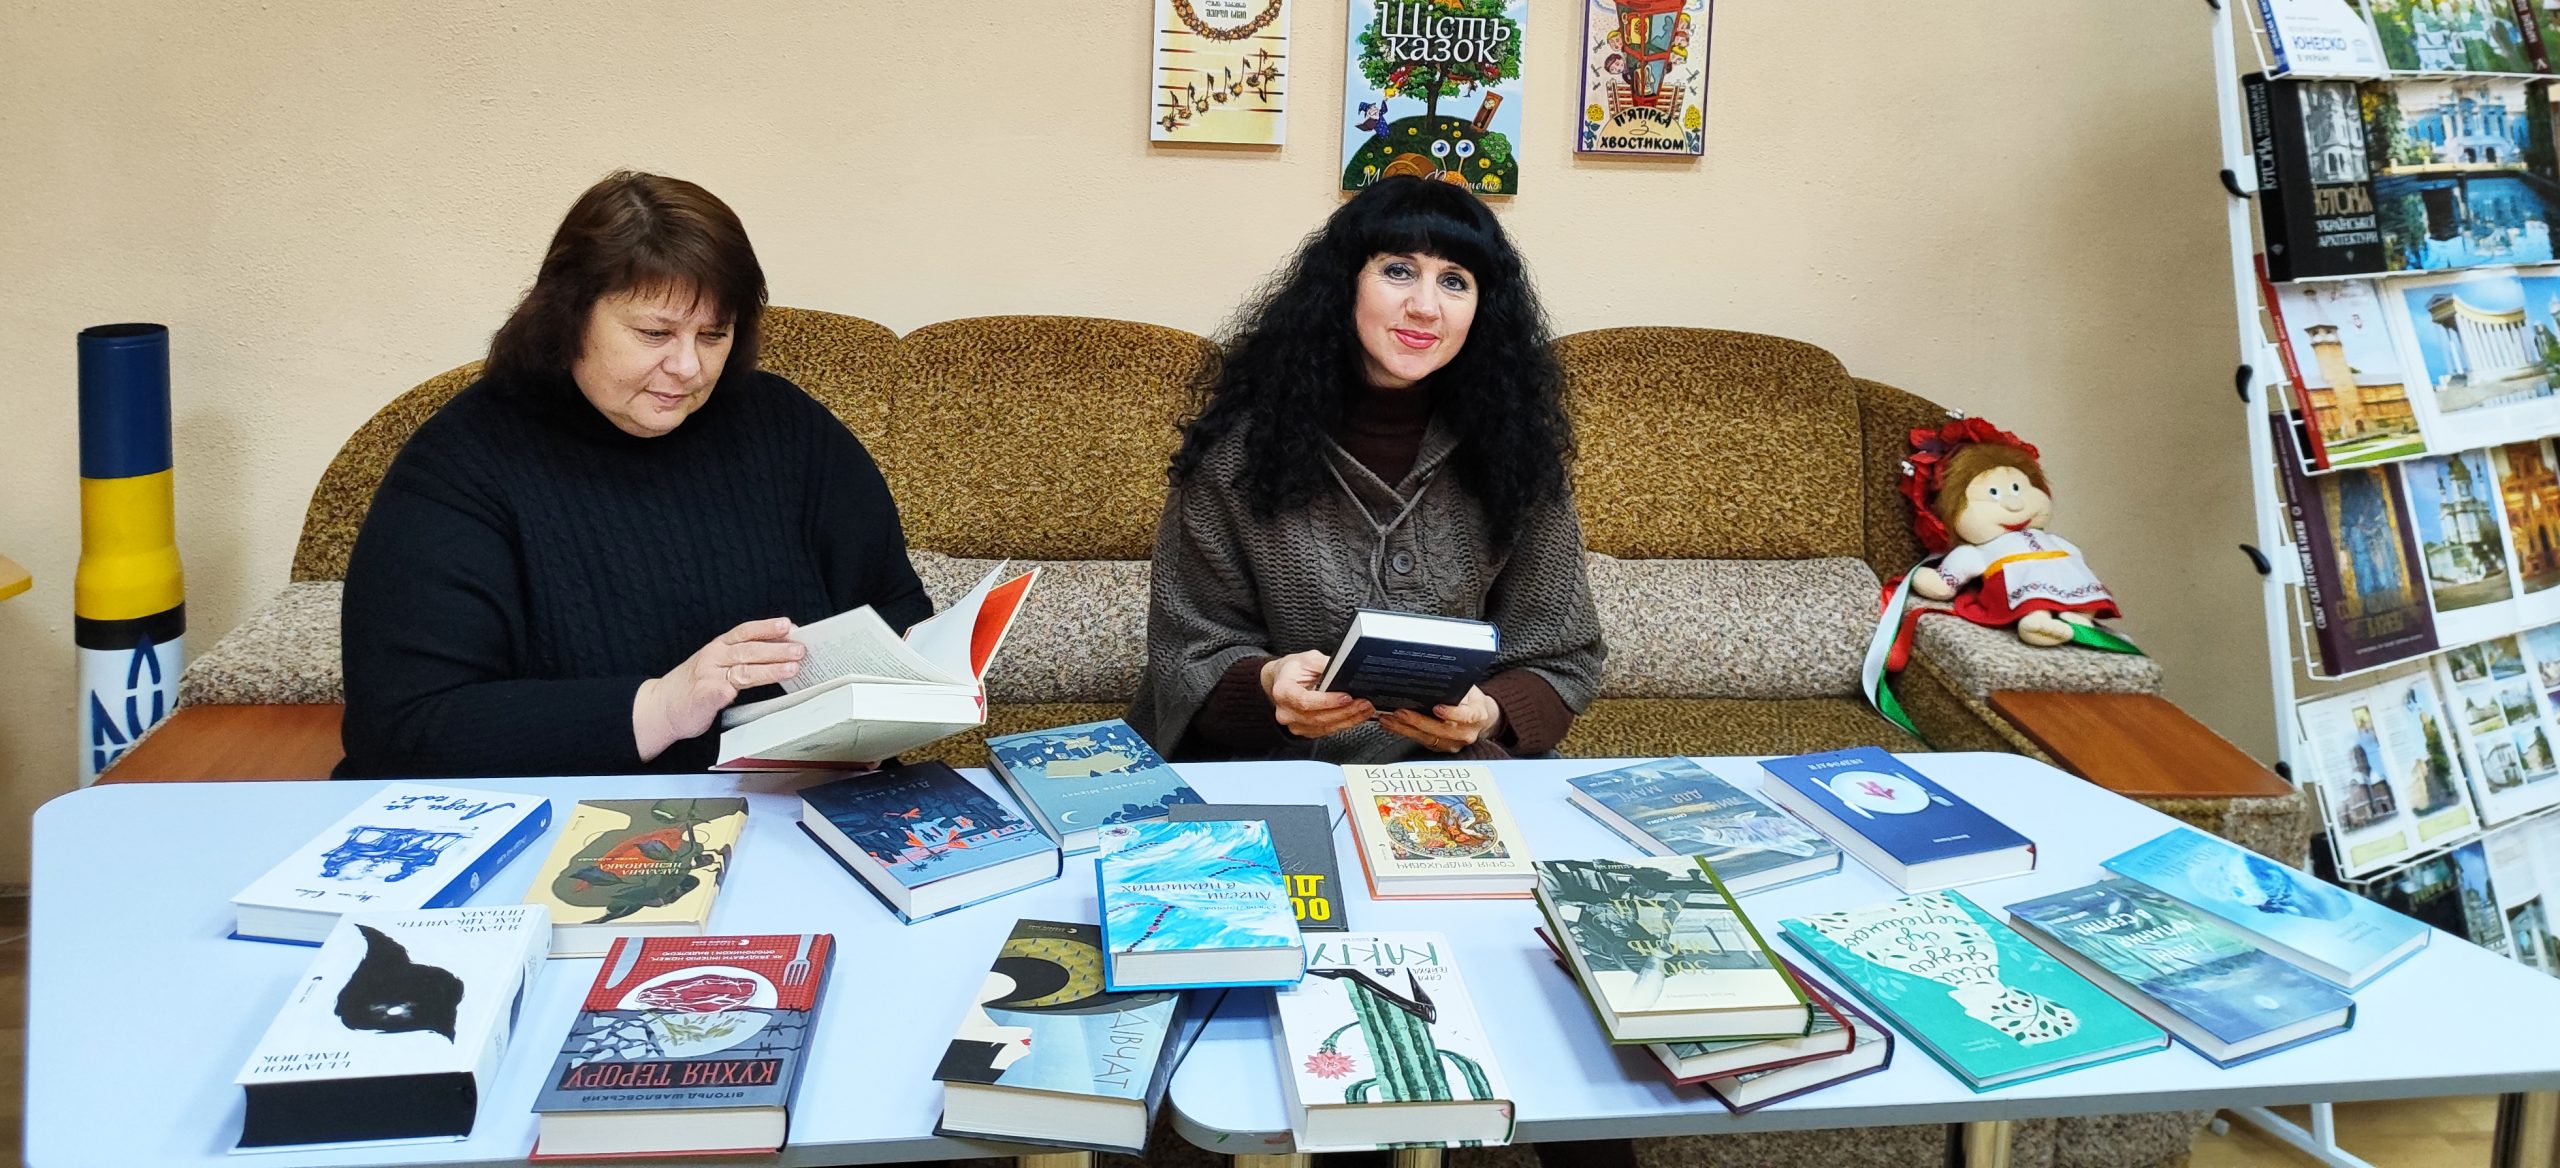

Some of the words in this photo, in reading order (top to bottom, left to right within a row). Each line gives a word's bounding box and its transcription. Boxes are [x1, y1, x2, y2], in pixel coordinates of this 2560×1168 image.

[1378, 1, 1511, 41] Шість
[1387, 37, 1500, 63] казок
[2292, 36, 2347, 51] ЮНЕСКО
[1600, 136, 1684, 150] ХВОСТИКОМ
[1364, 768, 1471, 779] АВСТРІЯ
[1371, 779, 1478, 793] ФЕЛІКС
[1206, 891, 1271, 901] Ангели
[562, 1062, 672, 1089] ТЕРОРУ
[679, 1061, 777, 1086] КУХНЯ
[581, 1092, 684, 1102] ШАБЛОВСЬКИЙ
[686, 1091, 745, 1099] ВІТОЛЬД
